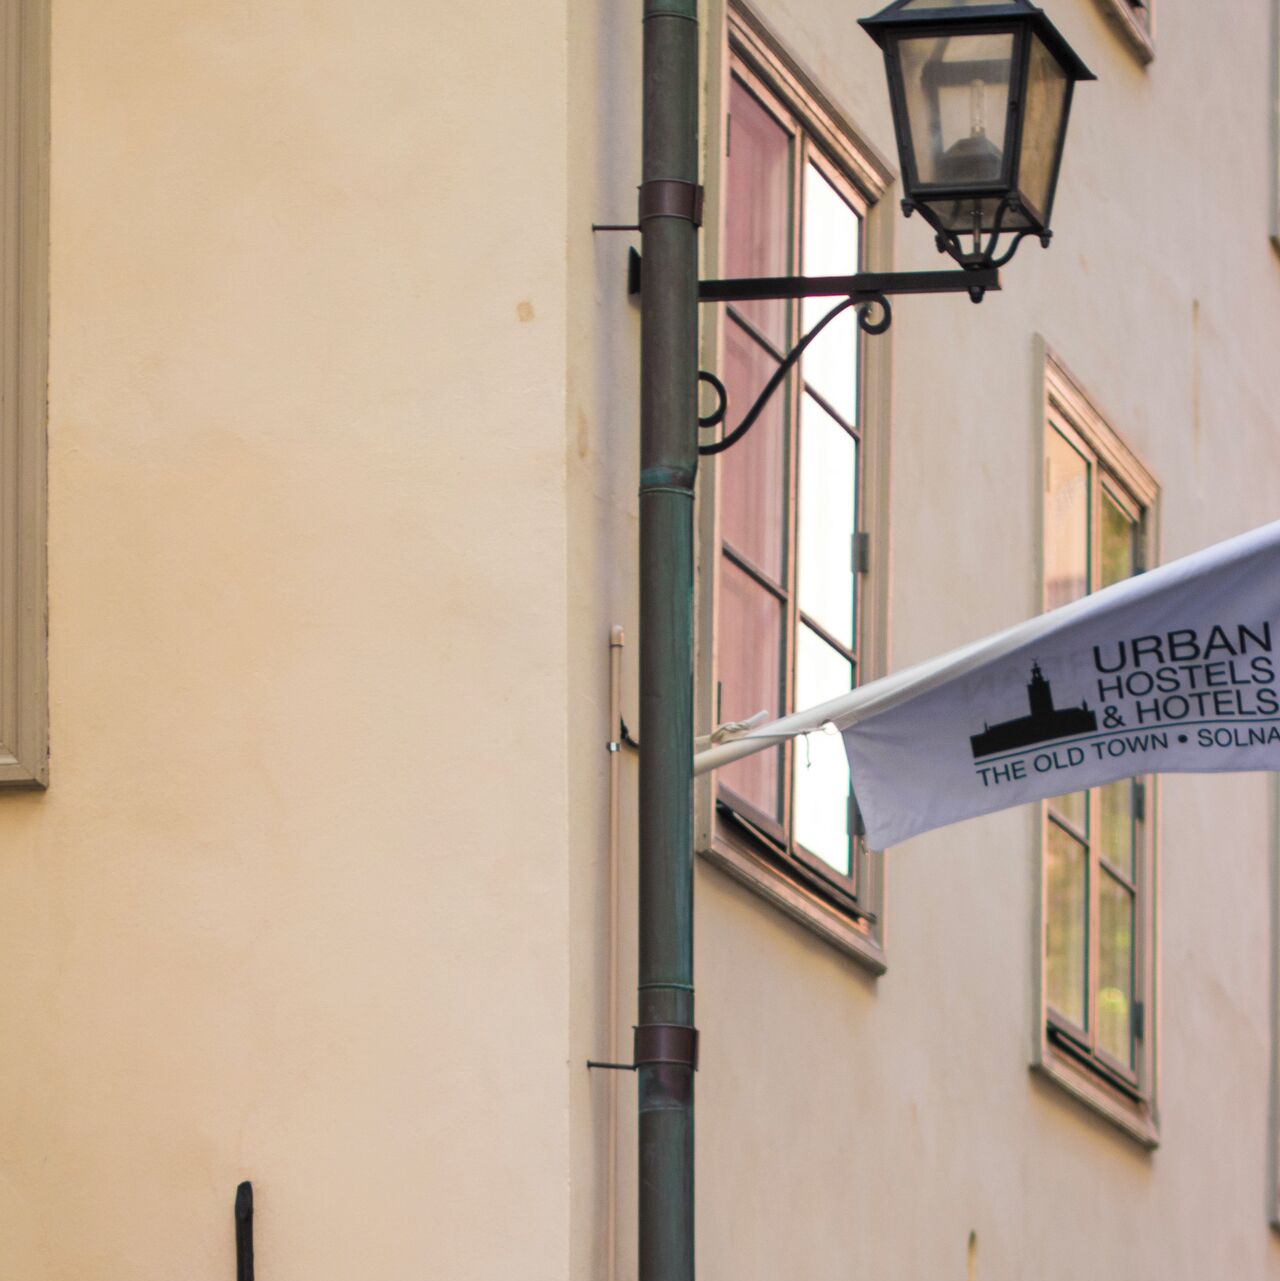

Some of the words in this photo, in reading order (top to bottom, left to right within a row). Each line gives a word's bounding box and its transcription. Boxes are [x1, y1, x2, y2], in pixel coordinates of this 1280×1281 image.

[1093, 621, 1272, 674] URBAN
[1097, 656, 1275, 702] HOSTELS
[1102, 705, 1126, 729] &
[1136, 688, 1280, 724] HOTELS
[976, 760, 1027, 787] THE
[1033, 746, 1085, 773] OLD
[1091, 732, 1169, 760] TOWN
